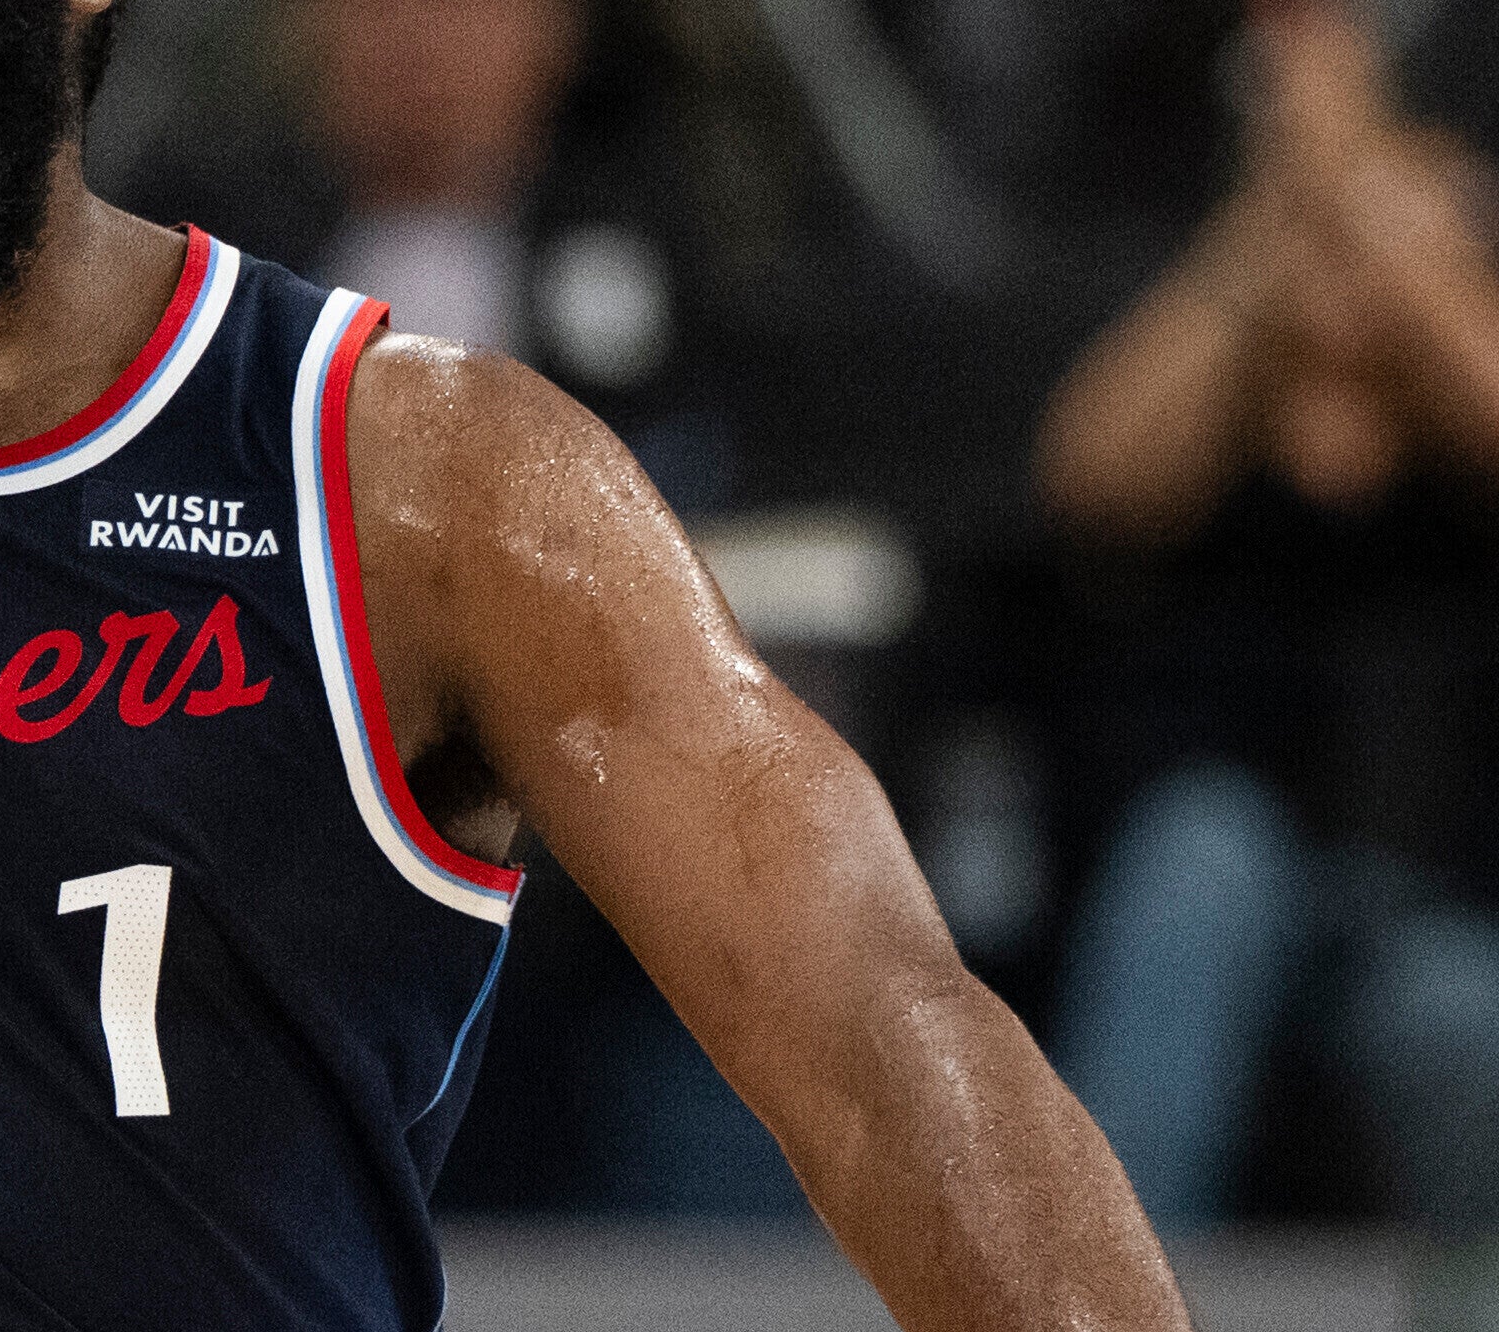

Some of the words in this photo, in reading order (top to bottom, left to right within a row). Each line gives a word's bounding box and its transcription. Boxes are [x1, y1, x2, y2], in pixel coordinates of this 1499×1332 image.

[134, 492, 245, 527] VISIT
[89, 520, 280, 558] RWANDA
[57, 864, 173, 1117] 1
